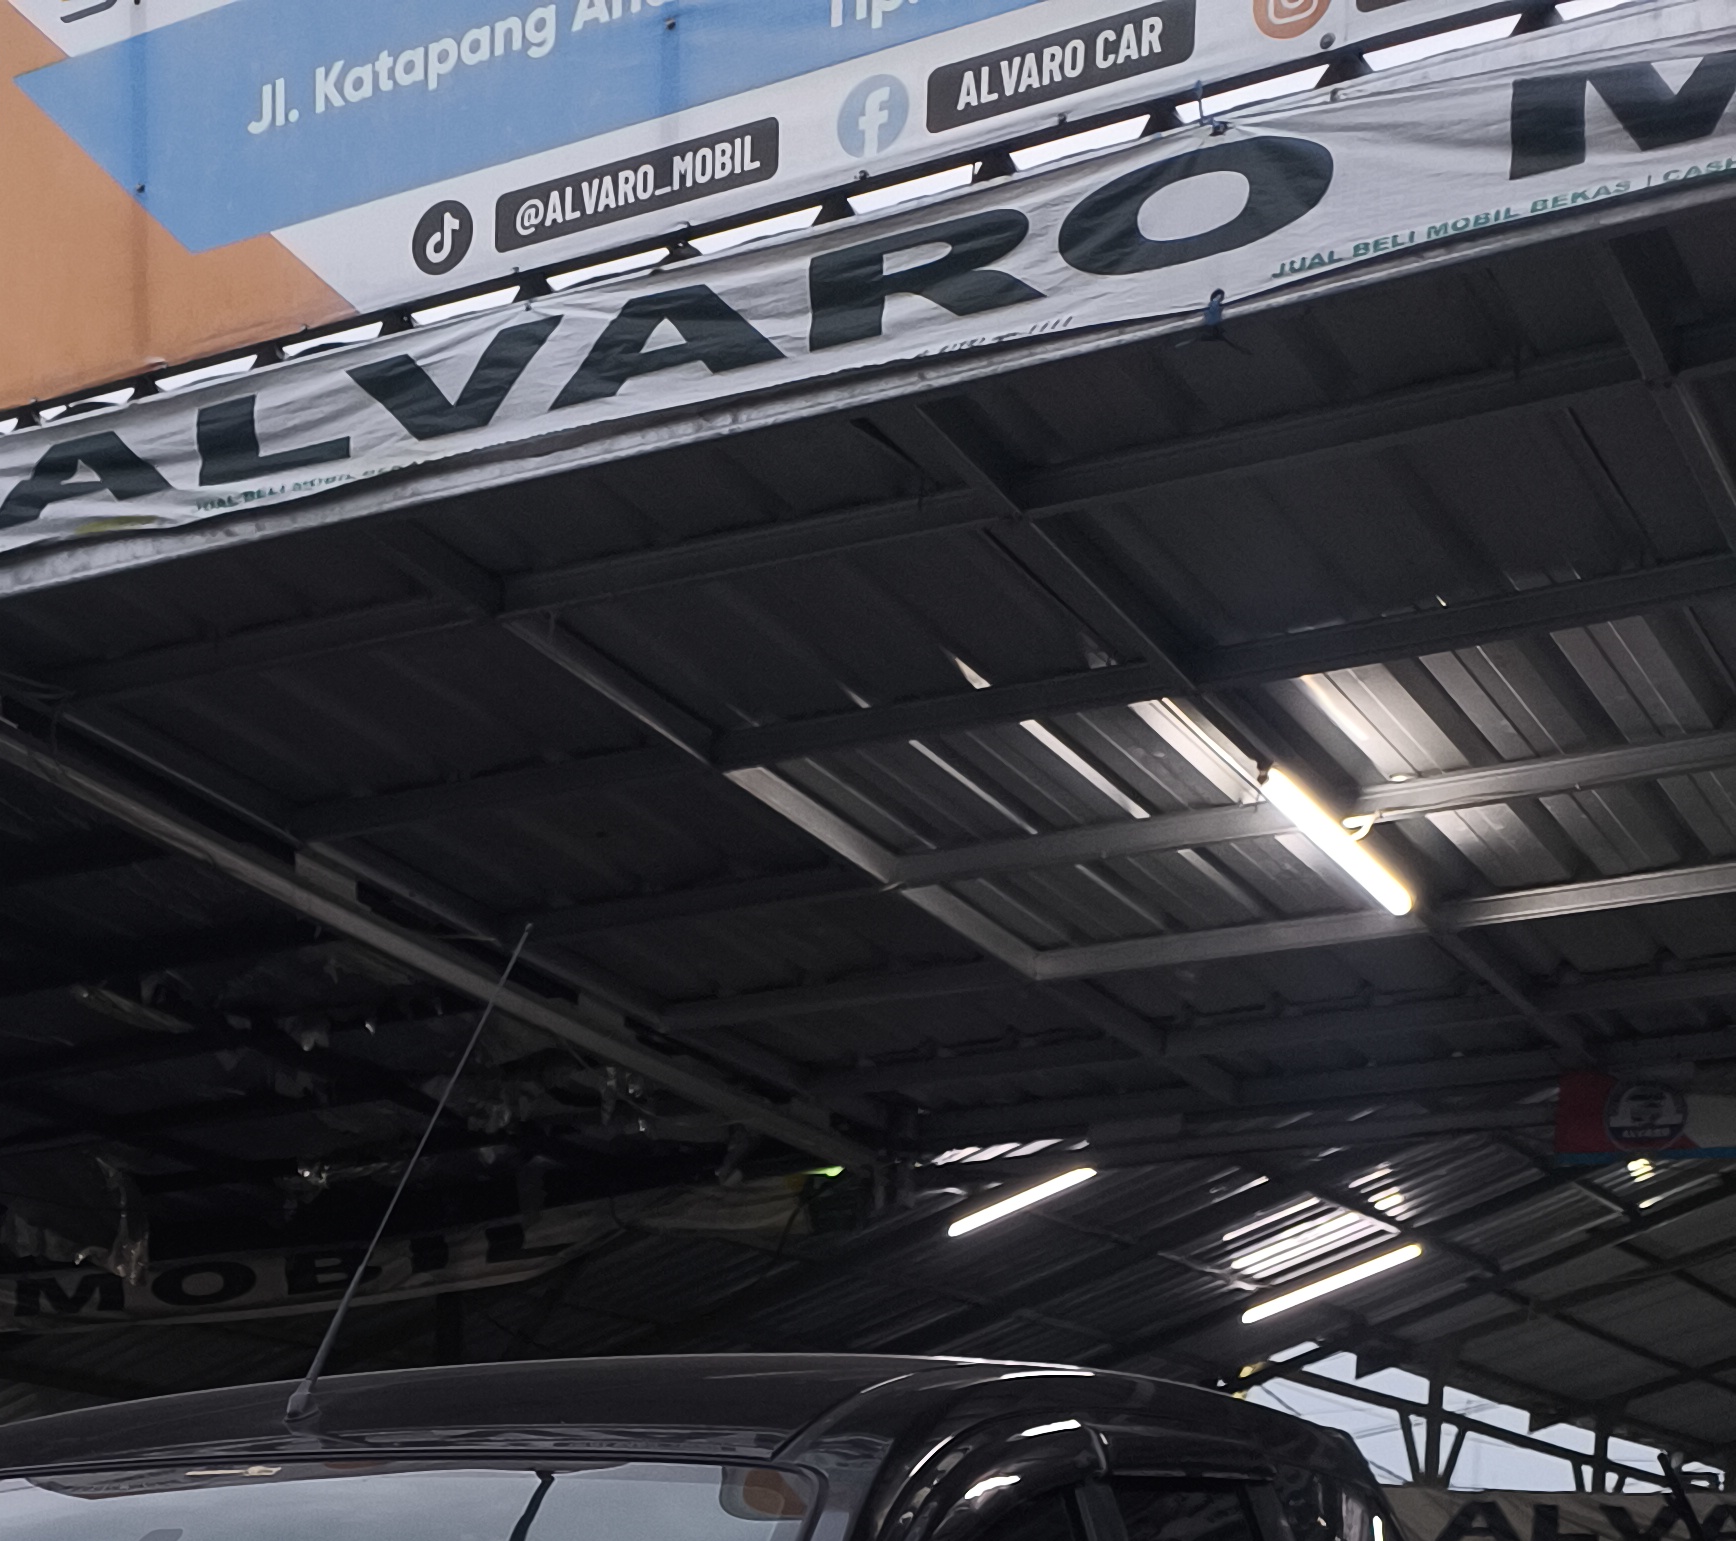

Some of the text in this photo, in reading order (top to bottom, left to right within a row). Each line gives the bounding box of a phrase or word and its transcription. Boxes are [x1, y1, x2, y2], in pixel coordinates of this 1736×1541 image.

[247, 83, 299, 134] Jl.
[315, 6, 557, 107] Katapang
[955, 17, 1163, 111] ALVARO CAR
[515, 134, 761, 237] @ALVARO_MOBIL
[1271, 250, 1344, 279] JUAL
[1352, 230, 1416, 258] BELI
[1426, 206, 1523, 240] MOBIL
[1530, 180, 1632, 215] BEKAS
